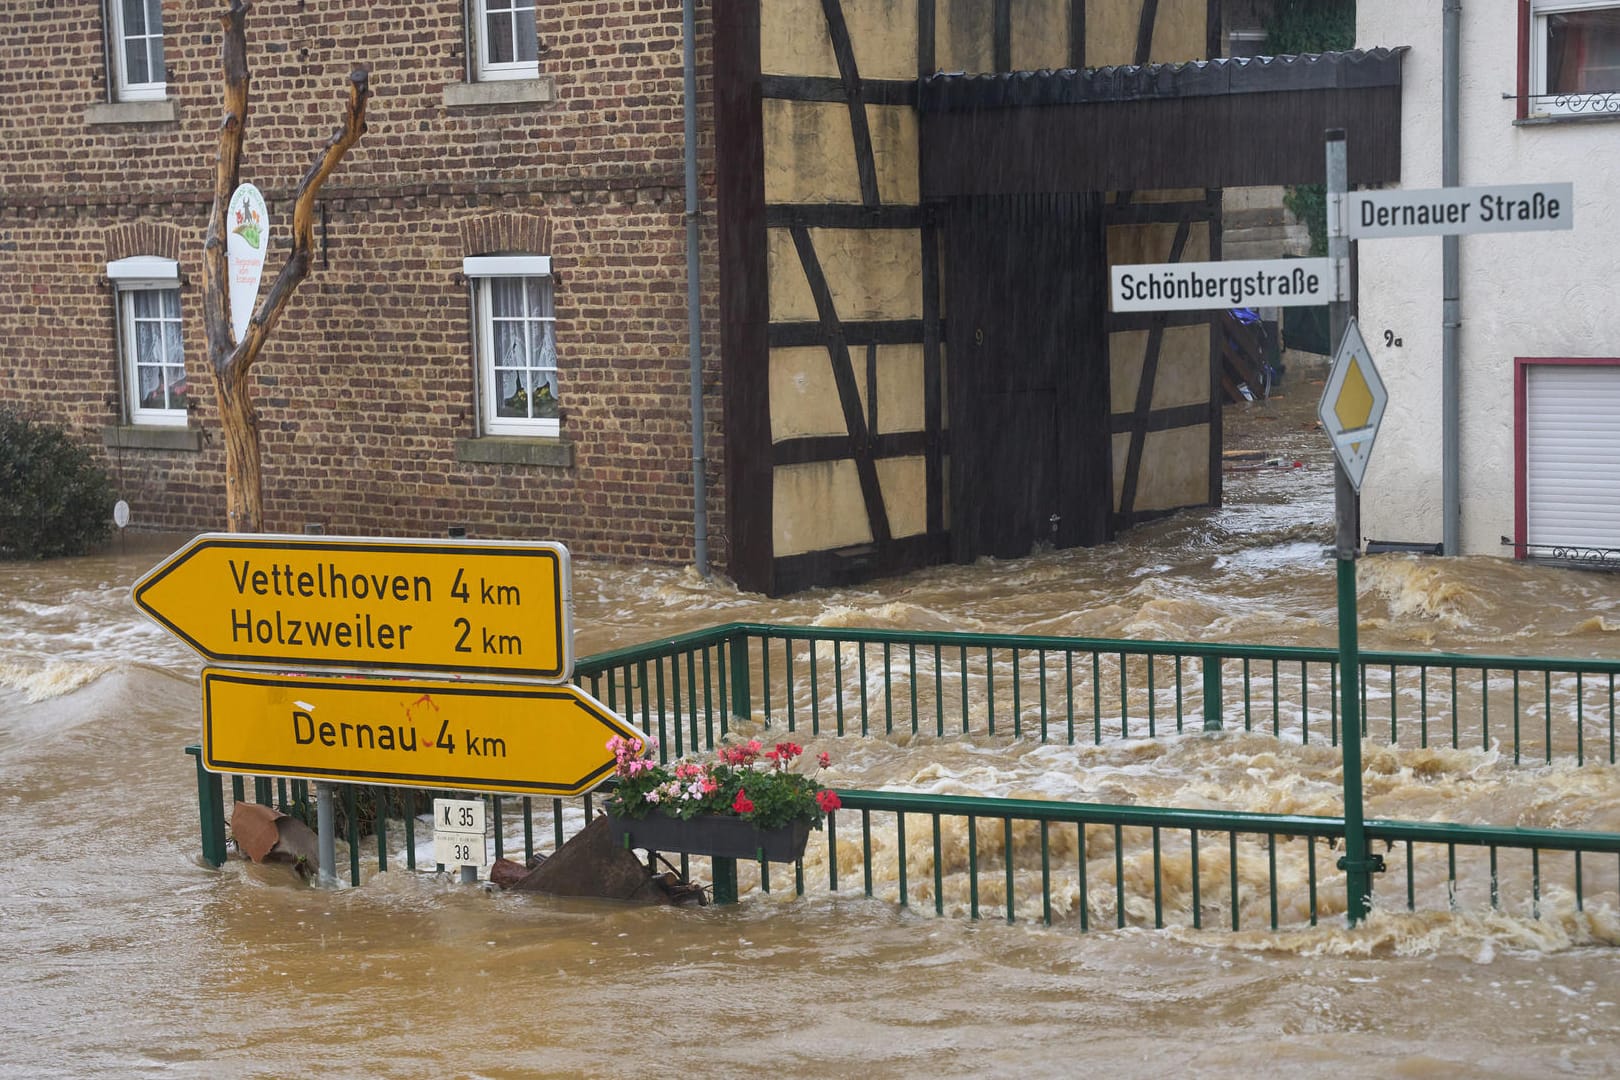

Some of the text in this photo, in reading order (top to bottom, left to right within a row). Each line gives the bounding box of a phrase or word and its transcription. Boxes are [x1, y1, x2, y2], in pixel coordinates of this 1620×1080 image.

[1361, 190, 1561, 229] Dernauer Straße
[1120, 267, 1320, 304] Schönbergstraße
[1383, 329, 1403, 348] 9a
[228, 559, 522, 606] Vettelhoven 4 km
[231, 608, 522, 656] Holzweiler 2 km
[292, 711, 508, 758] Dernau 4 km
[444, 806, 475, 827] K 35
